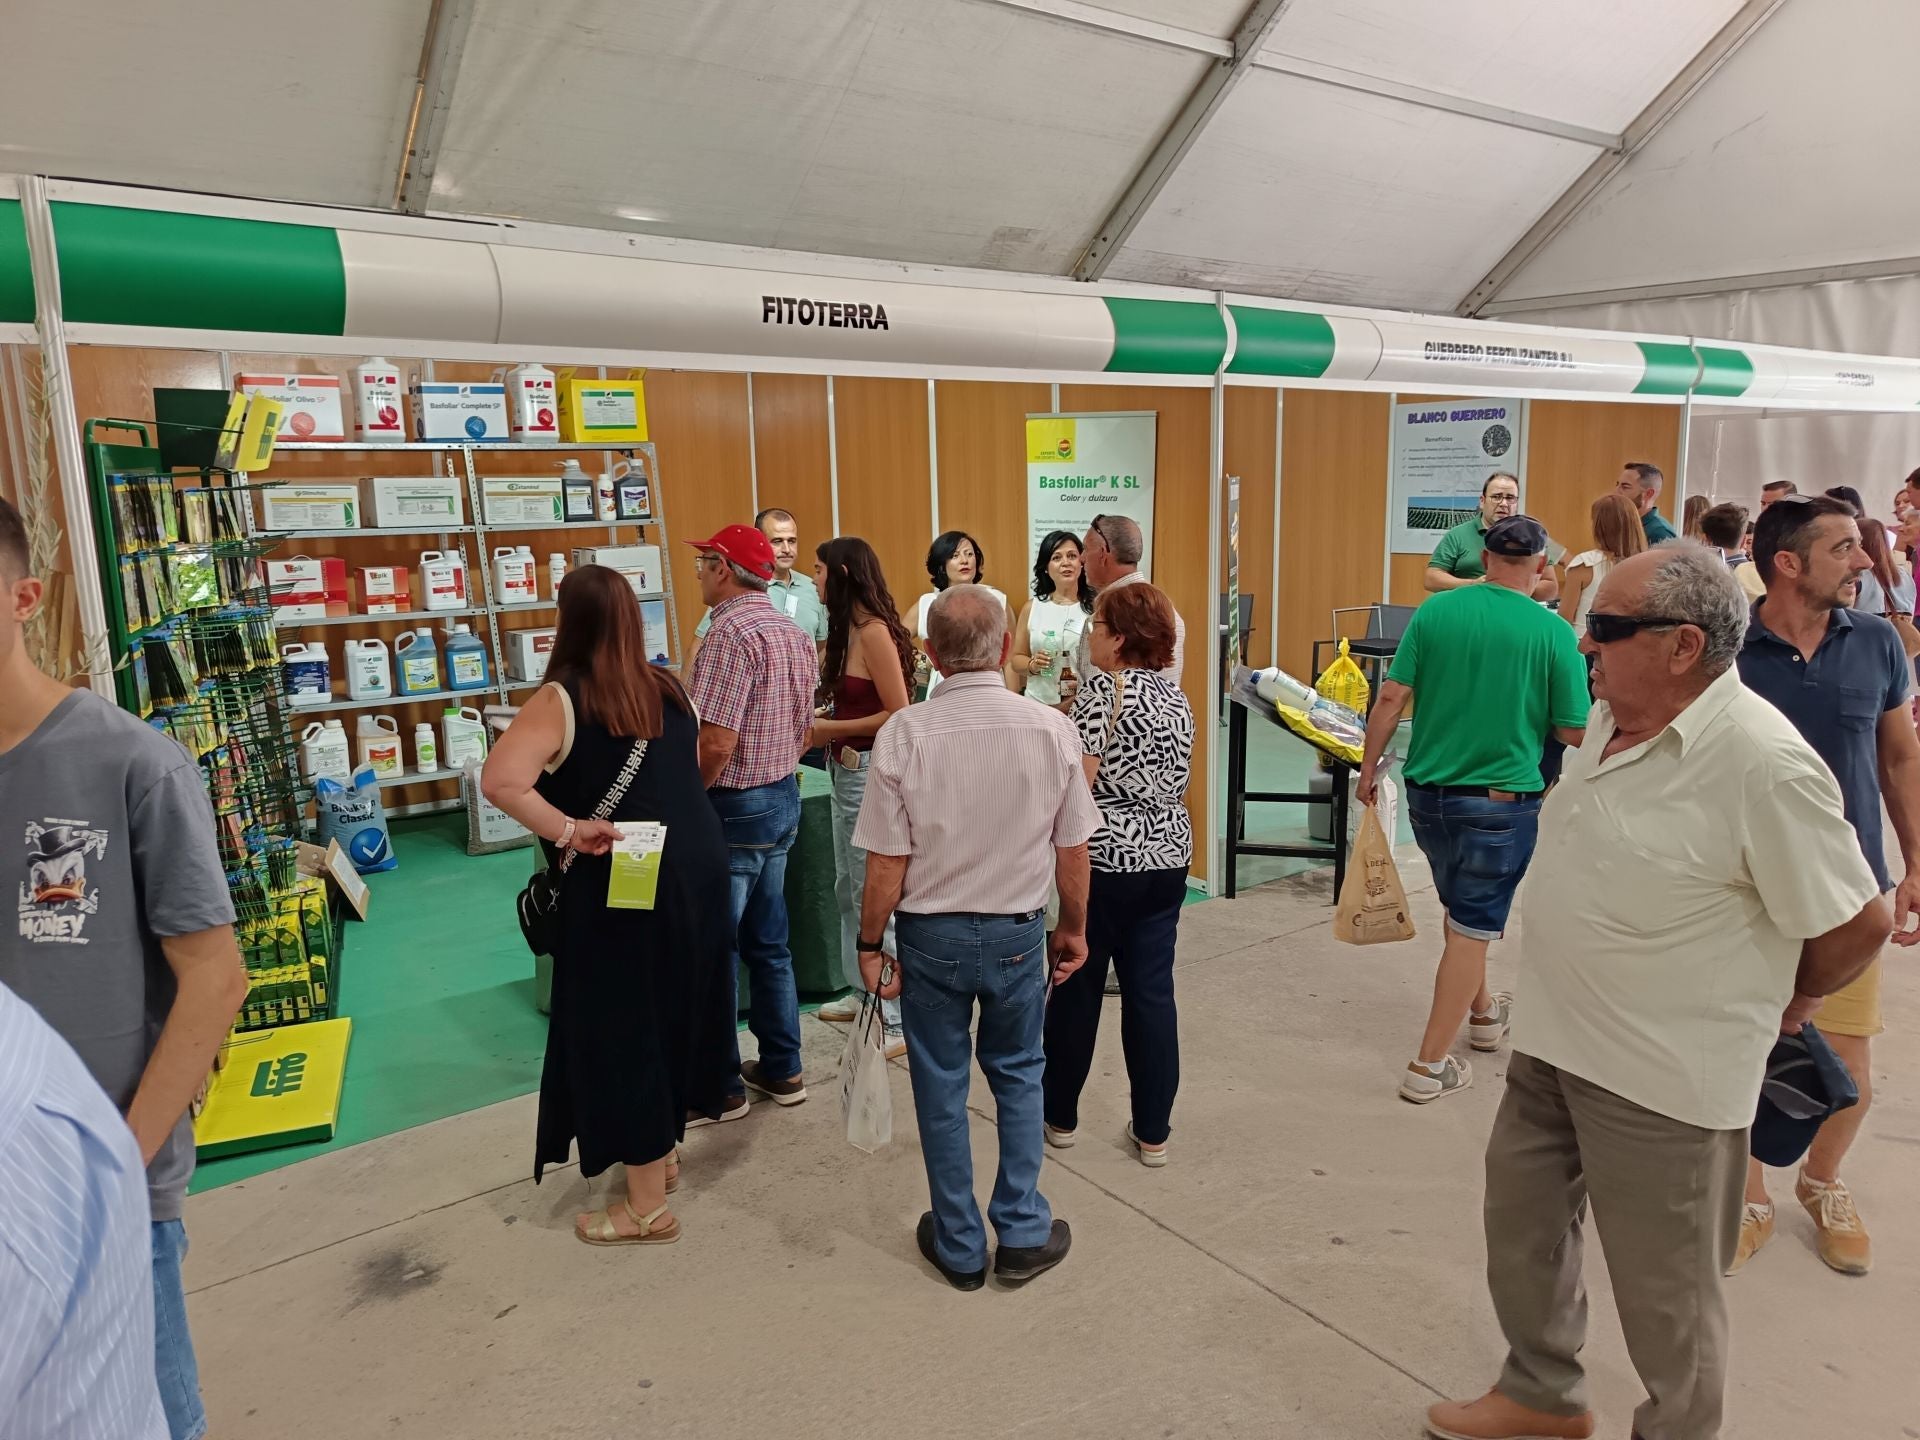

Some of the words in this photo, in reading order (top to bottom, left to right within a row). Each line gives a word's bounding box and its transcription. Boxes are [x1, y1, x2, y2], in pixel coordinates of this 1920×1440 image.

[762, 295, 889, 330] FITOTERRA
[1424, 341, 1484, 361] GUERRERO
[460, 402, 492, 410] Complete
[1407, 411, 1447, 424] BLANCO
[1450, 407, 1506, 422] GUERRERO
[1111, 476, 1120, 488] K
[1123, 475, 1140, 489] SL
[1060, 494, 1081, 502] Color
[1088, 494, 1118, 502] dulzura
[338, 811, 375, 824] Classic
[20, 913, 86, 939] MONEY
